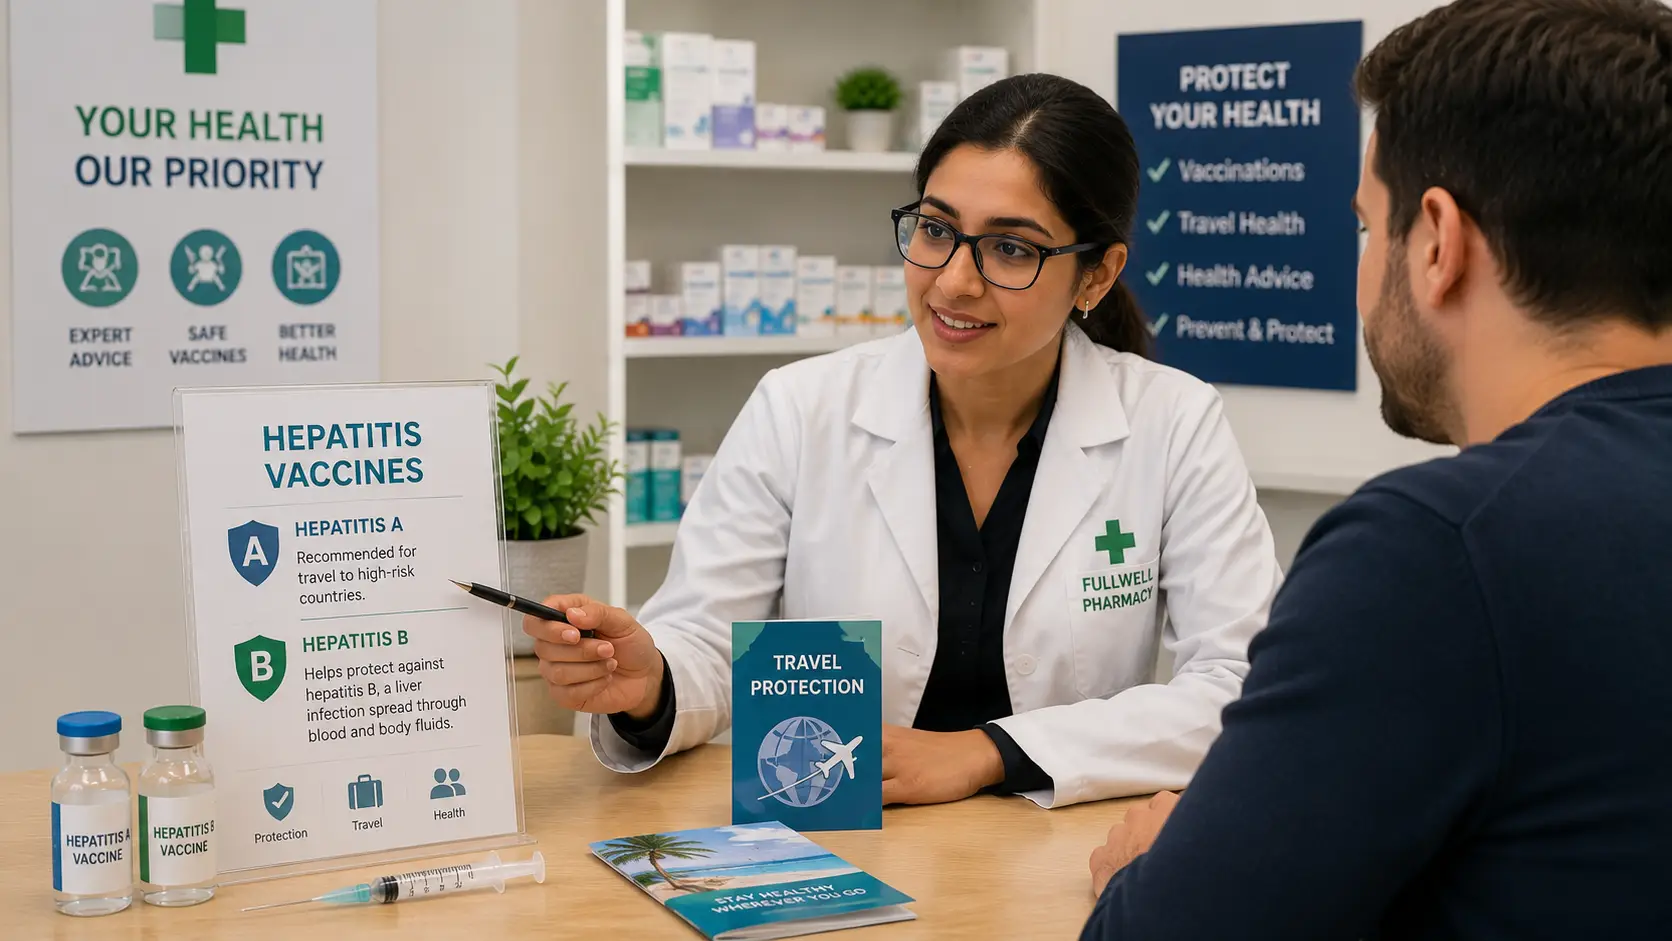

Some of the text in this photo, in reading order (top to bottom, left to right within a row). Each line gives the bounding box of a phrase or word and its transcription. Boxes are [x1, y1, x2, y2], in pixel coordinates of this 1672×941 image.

[1179, 62, 1291, 92] PROTECT
[75, 105, 324, 143] YOUR HEALTH
[1150, 99, 1321, 129] YOUR HEALTH
[75, 154, 324, 190] OUR PRIORITY
[1178, 158, 1305, 182] Vaccinations
[1177, 211, 1305, 235] Travel Health
[1177, 263, 1314, 290] Health Advice
[69, 327, 133, 344] EXPERT
[187, 325, 228, 341] SAFE
[279, 324, 336, 340] BETTER
[1176, 315, 1335, 344] Prevent & Protect
[69, 351, 132, 368] ADVICE
[169, 348, 247, 365] VACCINES
[278, 346, 337, 362] HEALTH
[263, 421, 422, 451] HEPATITIS
[264, 457, 424, 488] VACCINES
[295, 516, 404, 537] HEPATITIS A
[242, 536, 269, 567] A
[297, 545, 417, 565] Recommended for
[298, 565, 415, 585] travel to high-risk
[1082, 568, 1154, 592] FULLWELL
[299, 589, 366, 605] countries.
[1082, 585, 1153, 612] PHARMACY
[302, 630, 409, 652] HEPATITIS B
[250, 650, 274, 682] B
[304, 657, 445, 682] Helps protect against
[773, 654, 842, 671] TRAVEL
[305, 680, 422, 703] hepatitis B, a liver
[751, 678, 865, 696] PROTECTION
[306, 695, 467, 722] infection spread through
[308, 717, 454, 743] blood and body fluids.
[352, 817, 384, 831] Travel
[433, 807, 466, 821] Health
[66, 828, 131, 848] HEPATITIS A
[153, 820, 215, 839] HEPATITIS B
[254, 828, 308, 844] Protection
[73, 848, 123, 865] VACCINE
[160, 840, 208, 856] VACCINE
[711, 888, 867, 914] WHEREVER YOU GO
[714, 884, 835, 904] STAY HEALTHY
